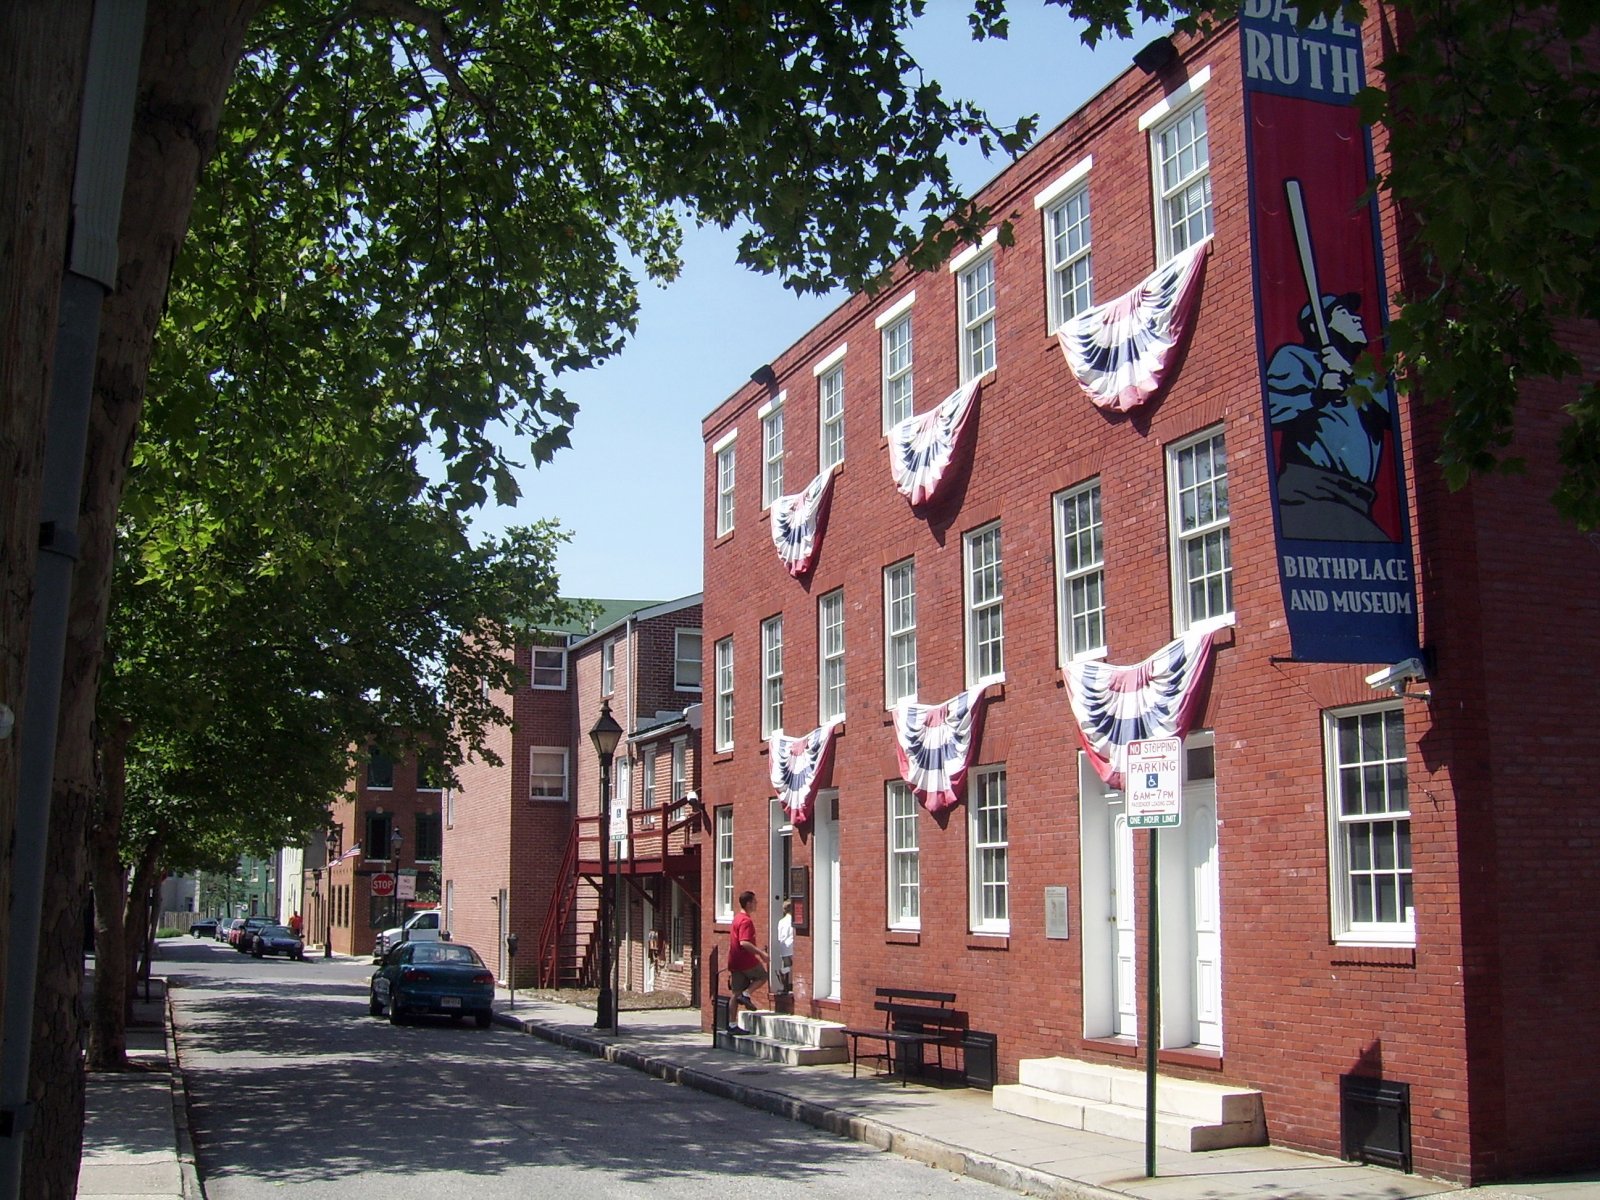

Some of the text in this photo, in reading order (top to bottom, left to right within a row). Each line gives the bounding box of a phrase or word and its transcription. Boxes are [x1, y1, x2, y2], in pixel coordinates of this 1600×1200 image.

[1244, 28, 1360, 95] RUTH
[1283, 555, 1408, 581] BIRTHPLACE
[1290, 589, 1412, 614] AND MUSEUM
[1130, 741, 1177, 754] NO STOPPING
[1131, 761, 1176, 773] PARKING
[1130, 814, 1177, 825] ONE HOUR LIMIT
[373, 880, 393, 889] STOP
